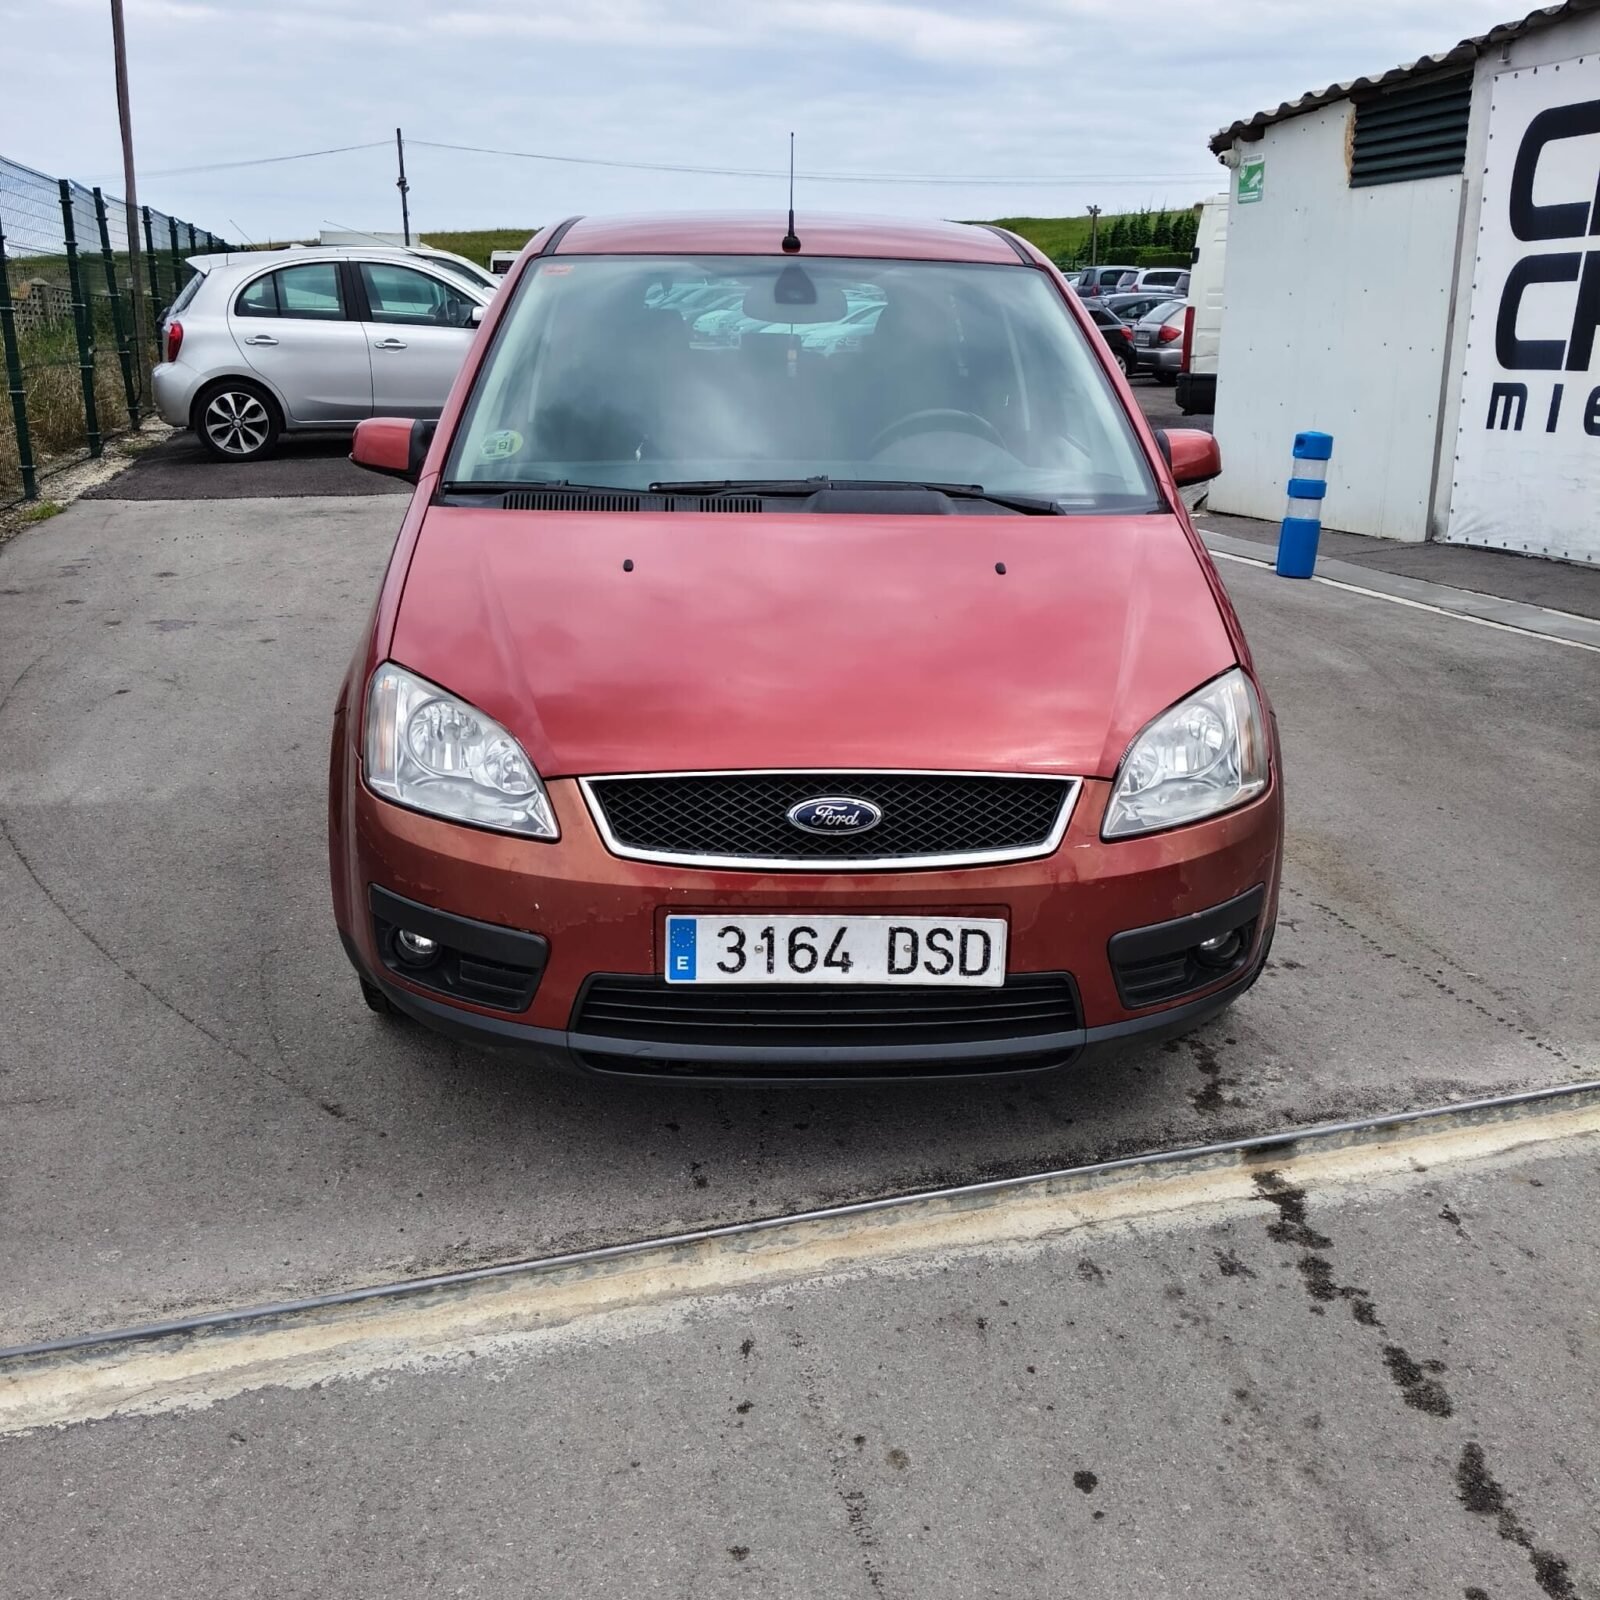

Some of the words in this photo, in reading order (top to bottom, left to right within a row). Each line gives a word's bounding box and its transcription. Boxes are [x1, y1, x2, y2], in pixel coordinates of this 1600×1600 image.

[811, 805, 860, 825] Ford
[716, 925, 854, 974] 3164
[887, 926, 992, 976] DSD
[676, 956, 689, 970] E
